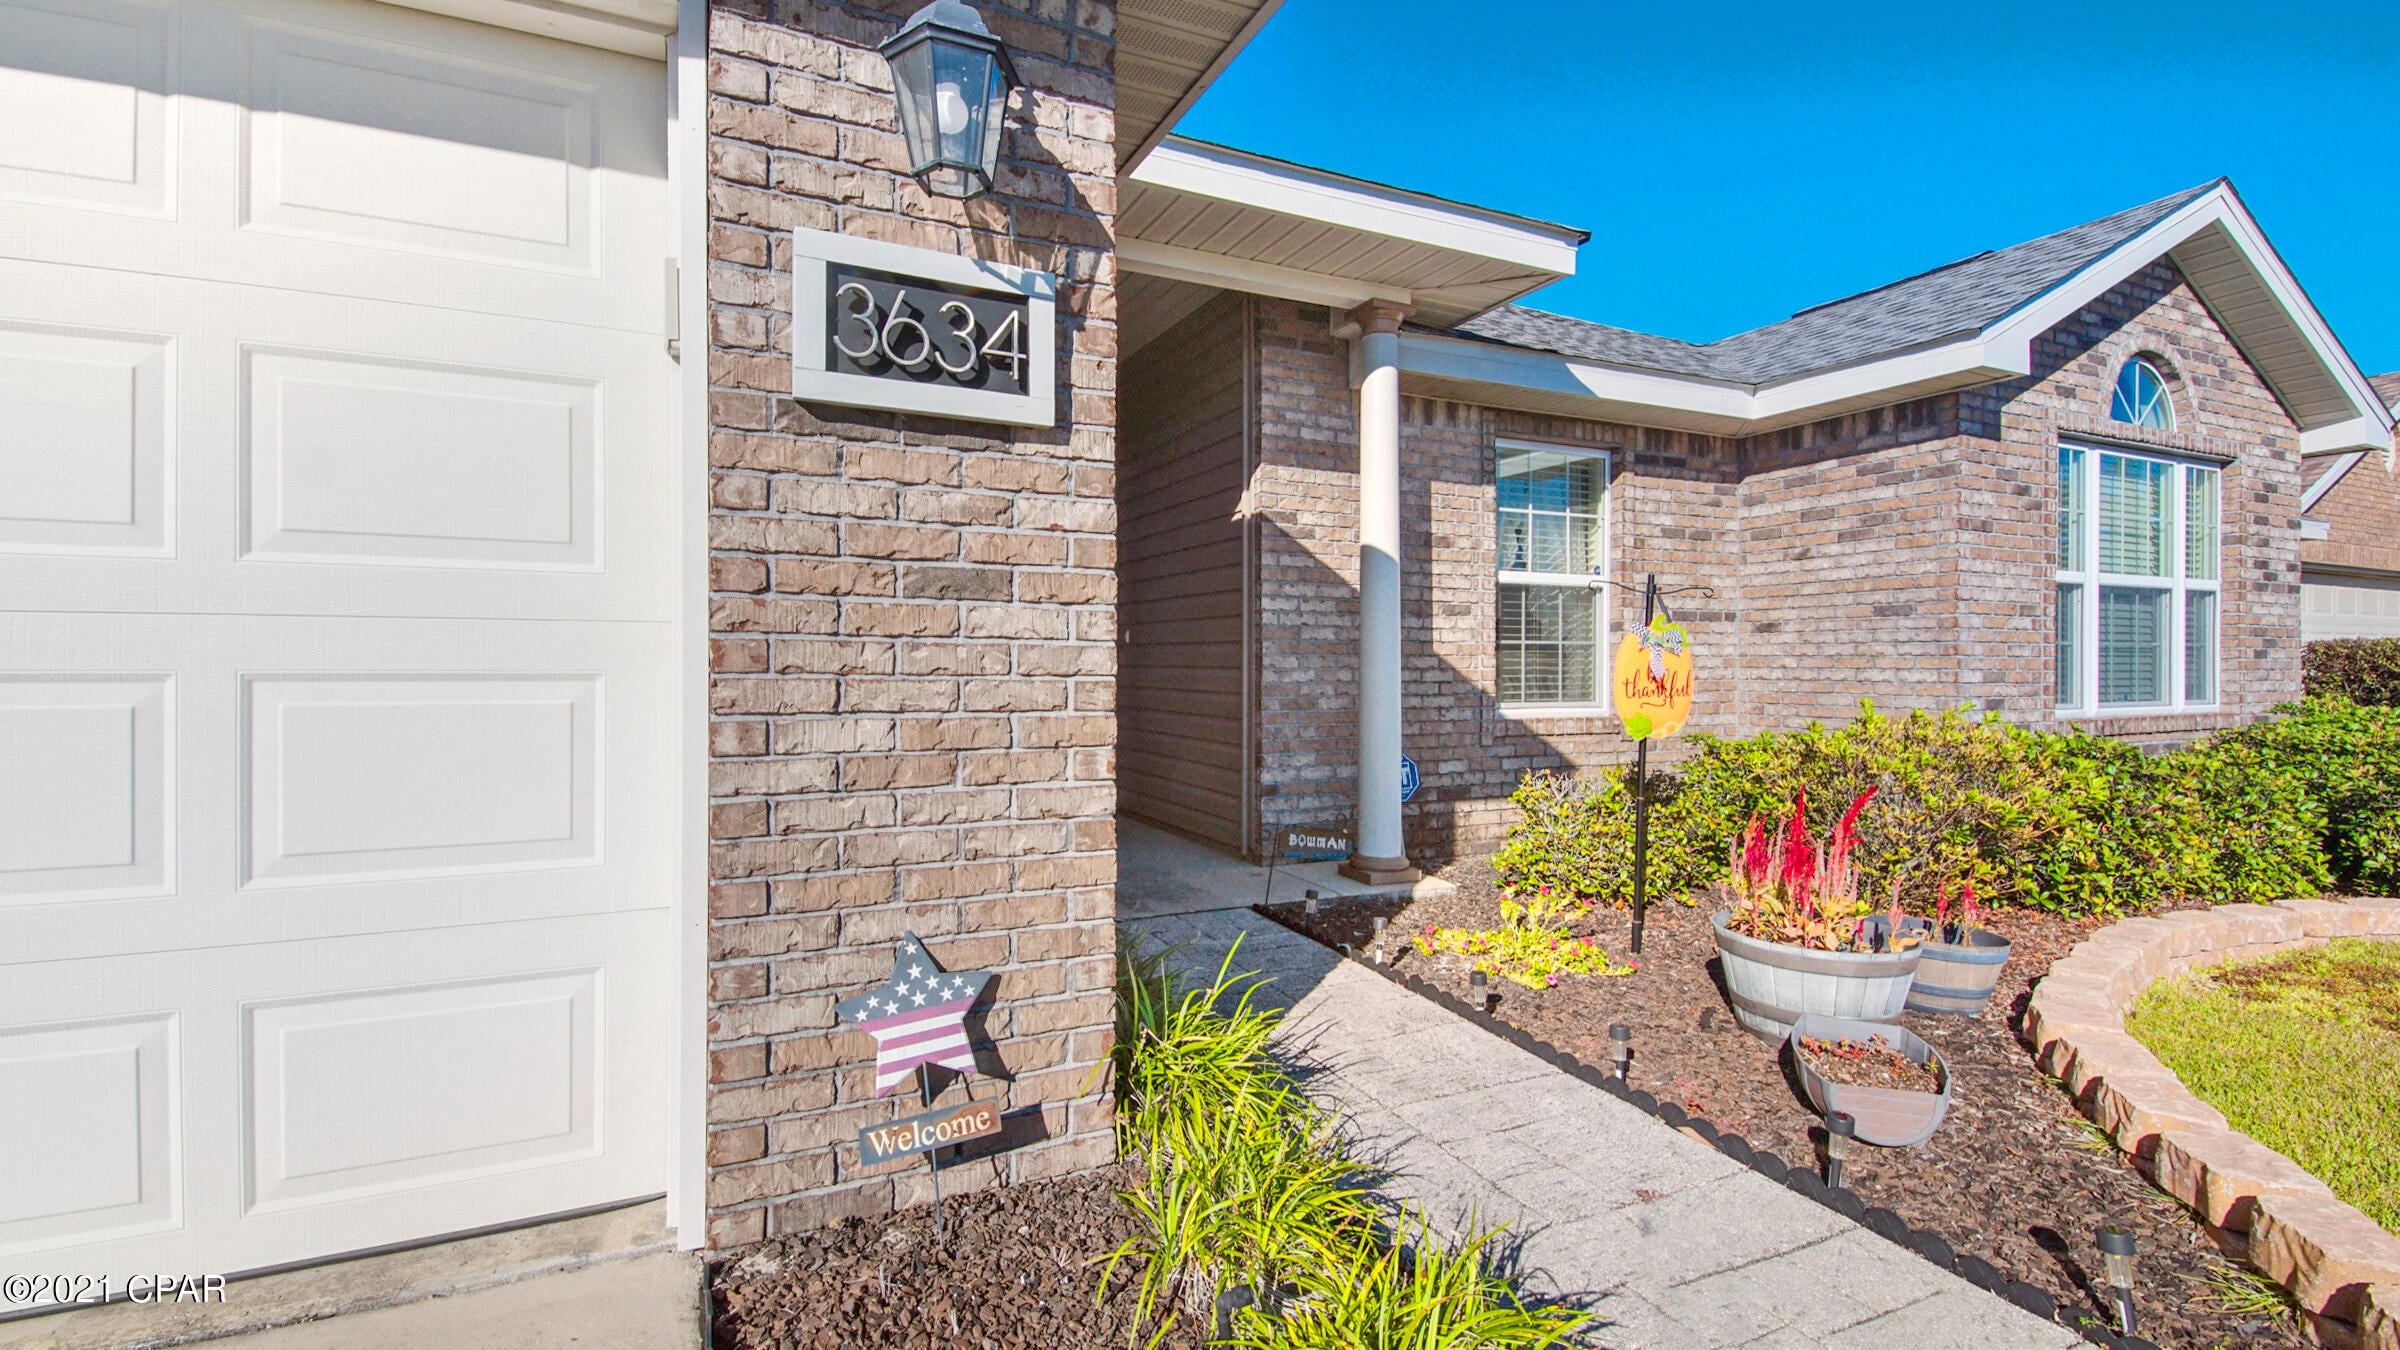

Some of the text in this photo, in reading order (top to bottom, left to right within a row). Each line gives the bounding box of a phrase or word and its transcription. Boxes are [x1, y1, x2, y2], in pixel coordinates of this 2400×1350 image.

[834, 282, 1027, 381] 3634
[1622, 668, 1691, 709] thankful
[1288, 833, 1346, 850] BOWMAN
[867, 1111, 991, 1157] Welcome
